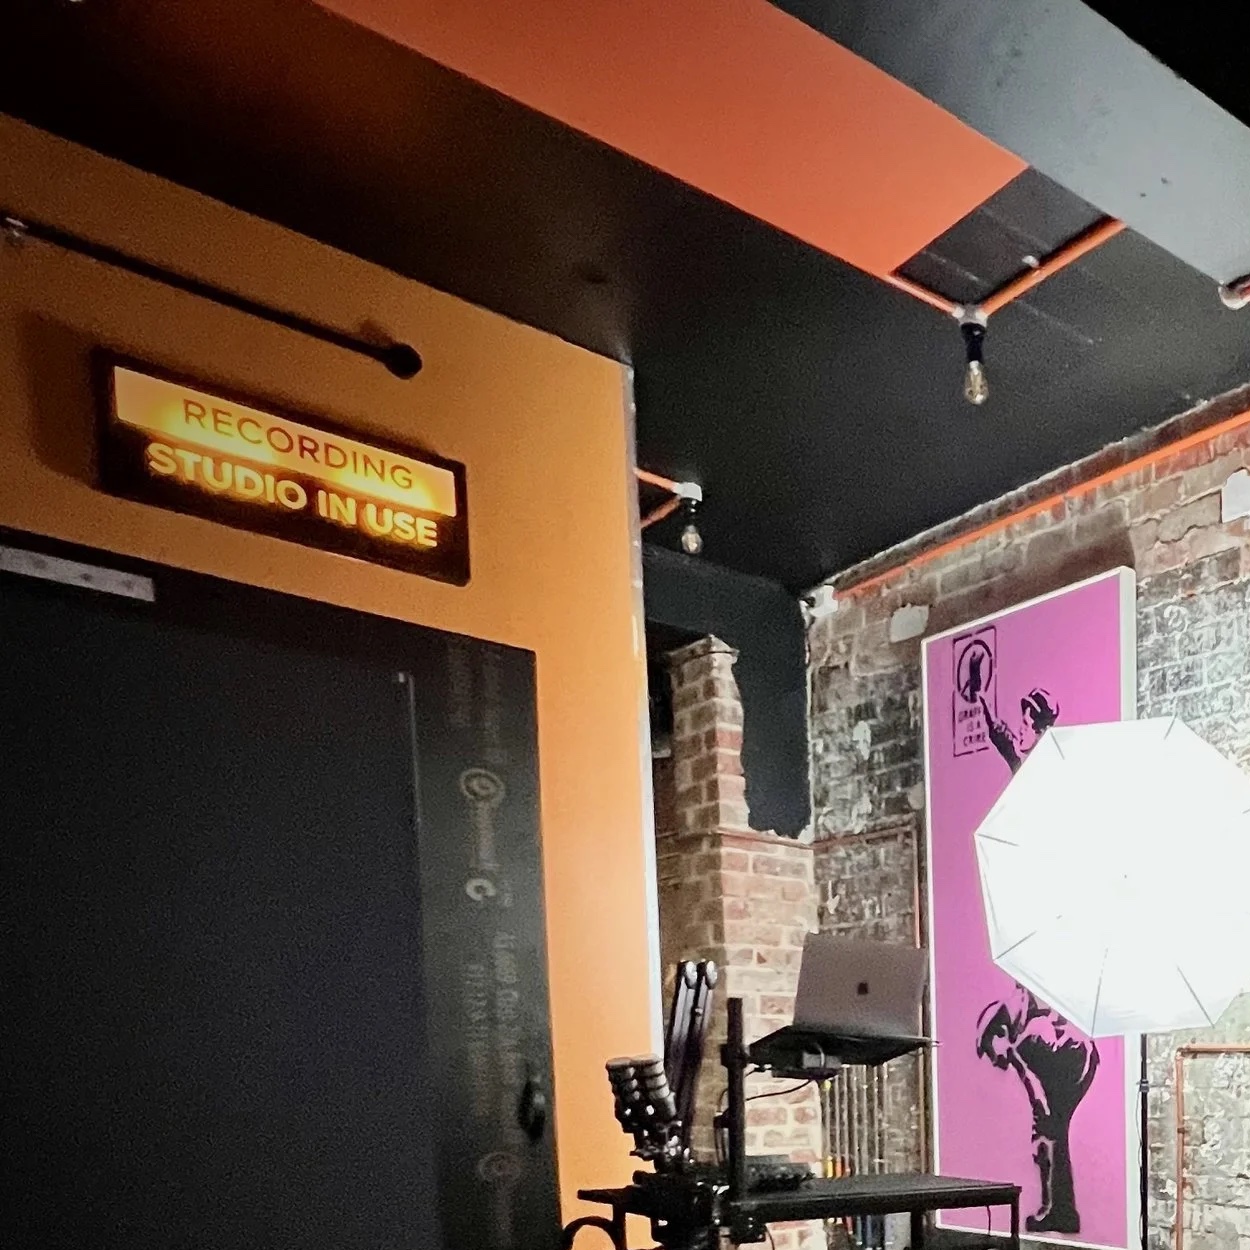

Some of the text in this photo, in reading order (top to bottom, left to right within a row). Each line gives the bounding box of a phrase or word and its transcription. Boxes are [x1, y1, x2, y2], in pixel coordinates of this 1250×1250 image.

[182, 399, 414, 489] RECORDING
[147, 442, 439, 548] STUDIO IN USE
